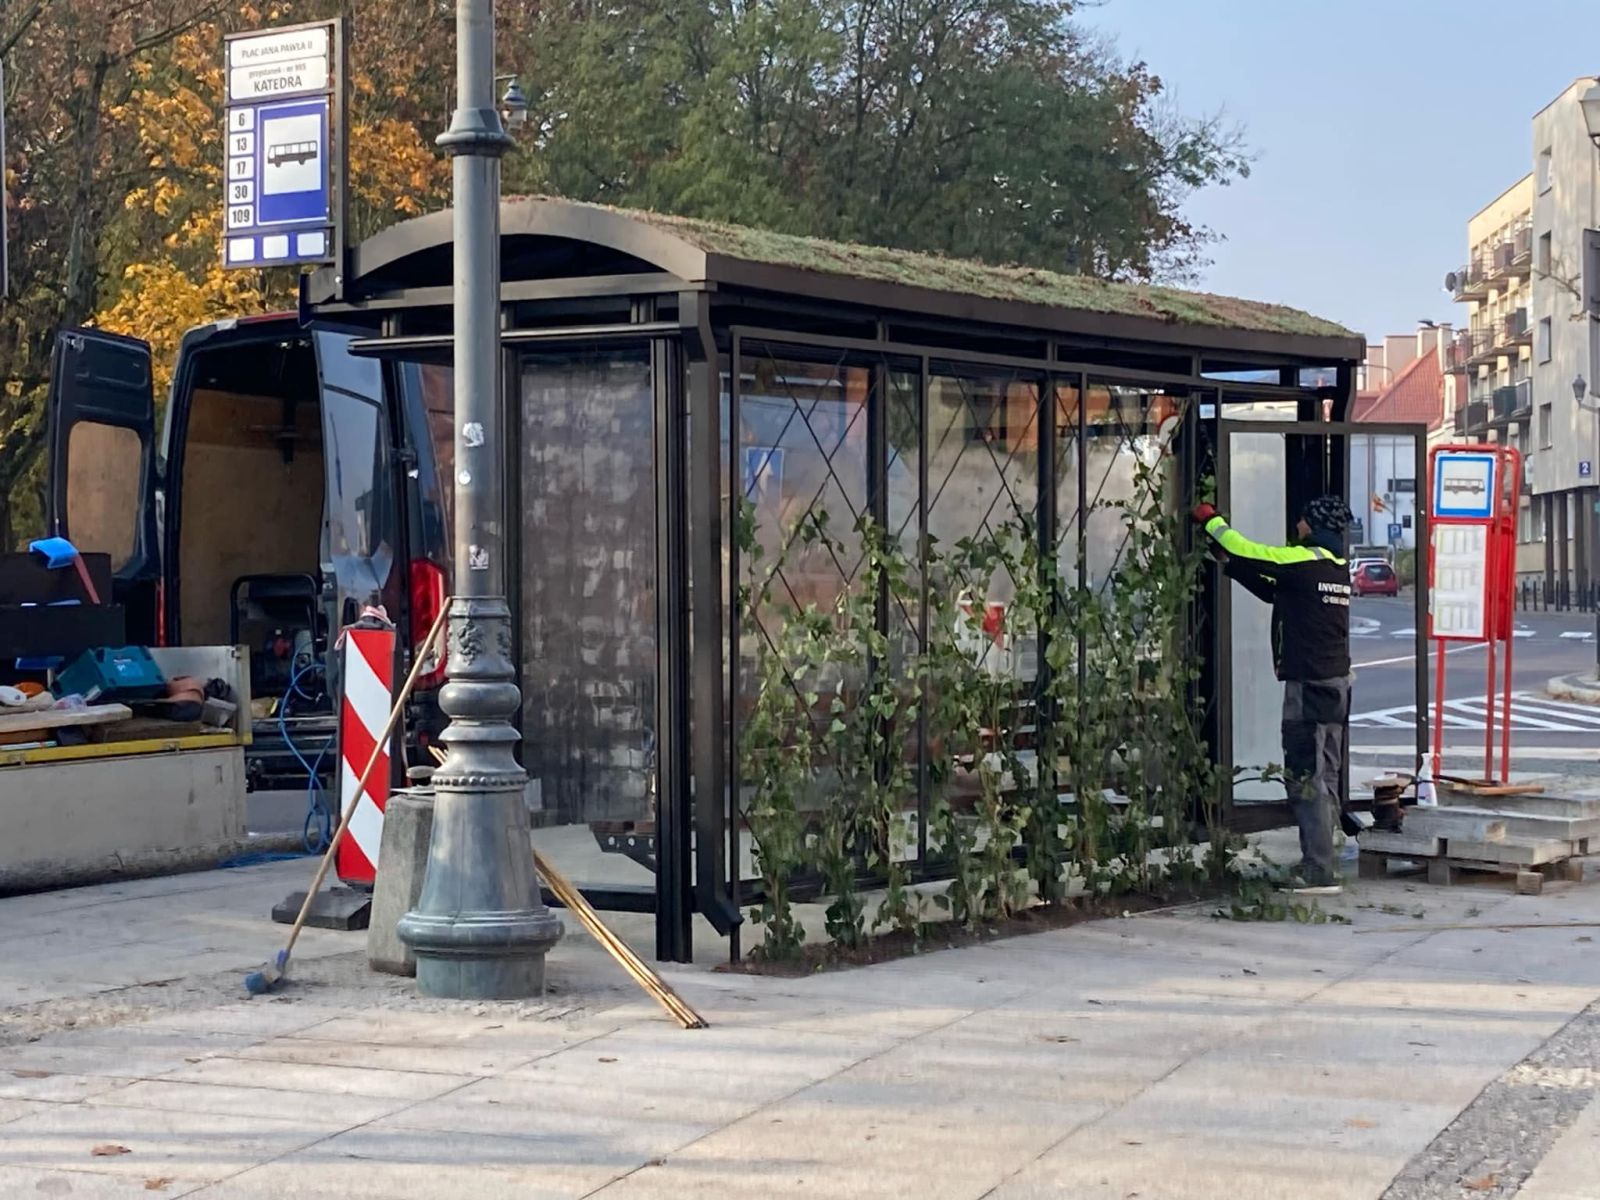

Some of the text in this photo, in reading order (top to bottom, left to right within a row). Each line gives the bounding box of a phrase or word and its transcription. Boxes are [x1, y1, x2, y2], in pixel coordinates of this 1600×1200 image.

[241, 48, 260, 59] PLAC
[260, 45, 279, 56] JANA
[253, 75, 302, 93] KATEDRA
[238, 112, 245, 127] 6
[236, 137, 247, 151] 13
[236, 160, 246, 175] 17
[234, 184, 248, 199] 30
[232, 209, 250, 224] 109
[1581, 462, 1589, 474] 2
